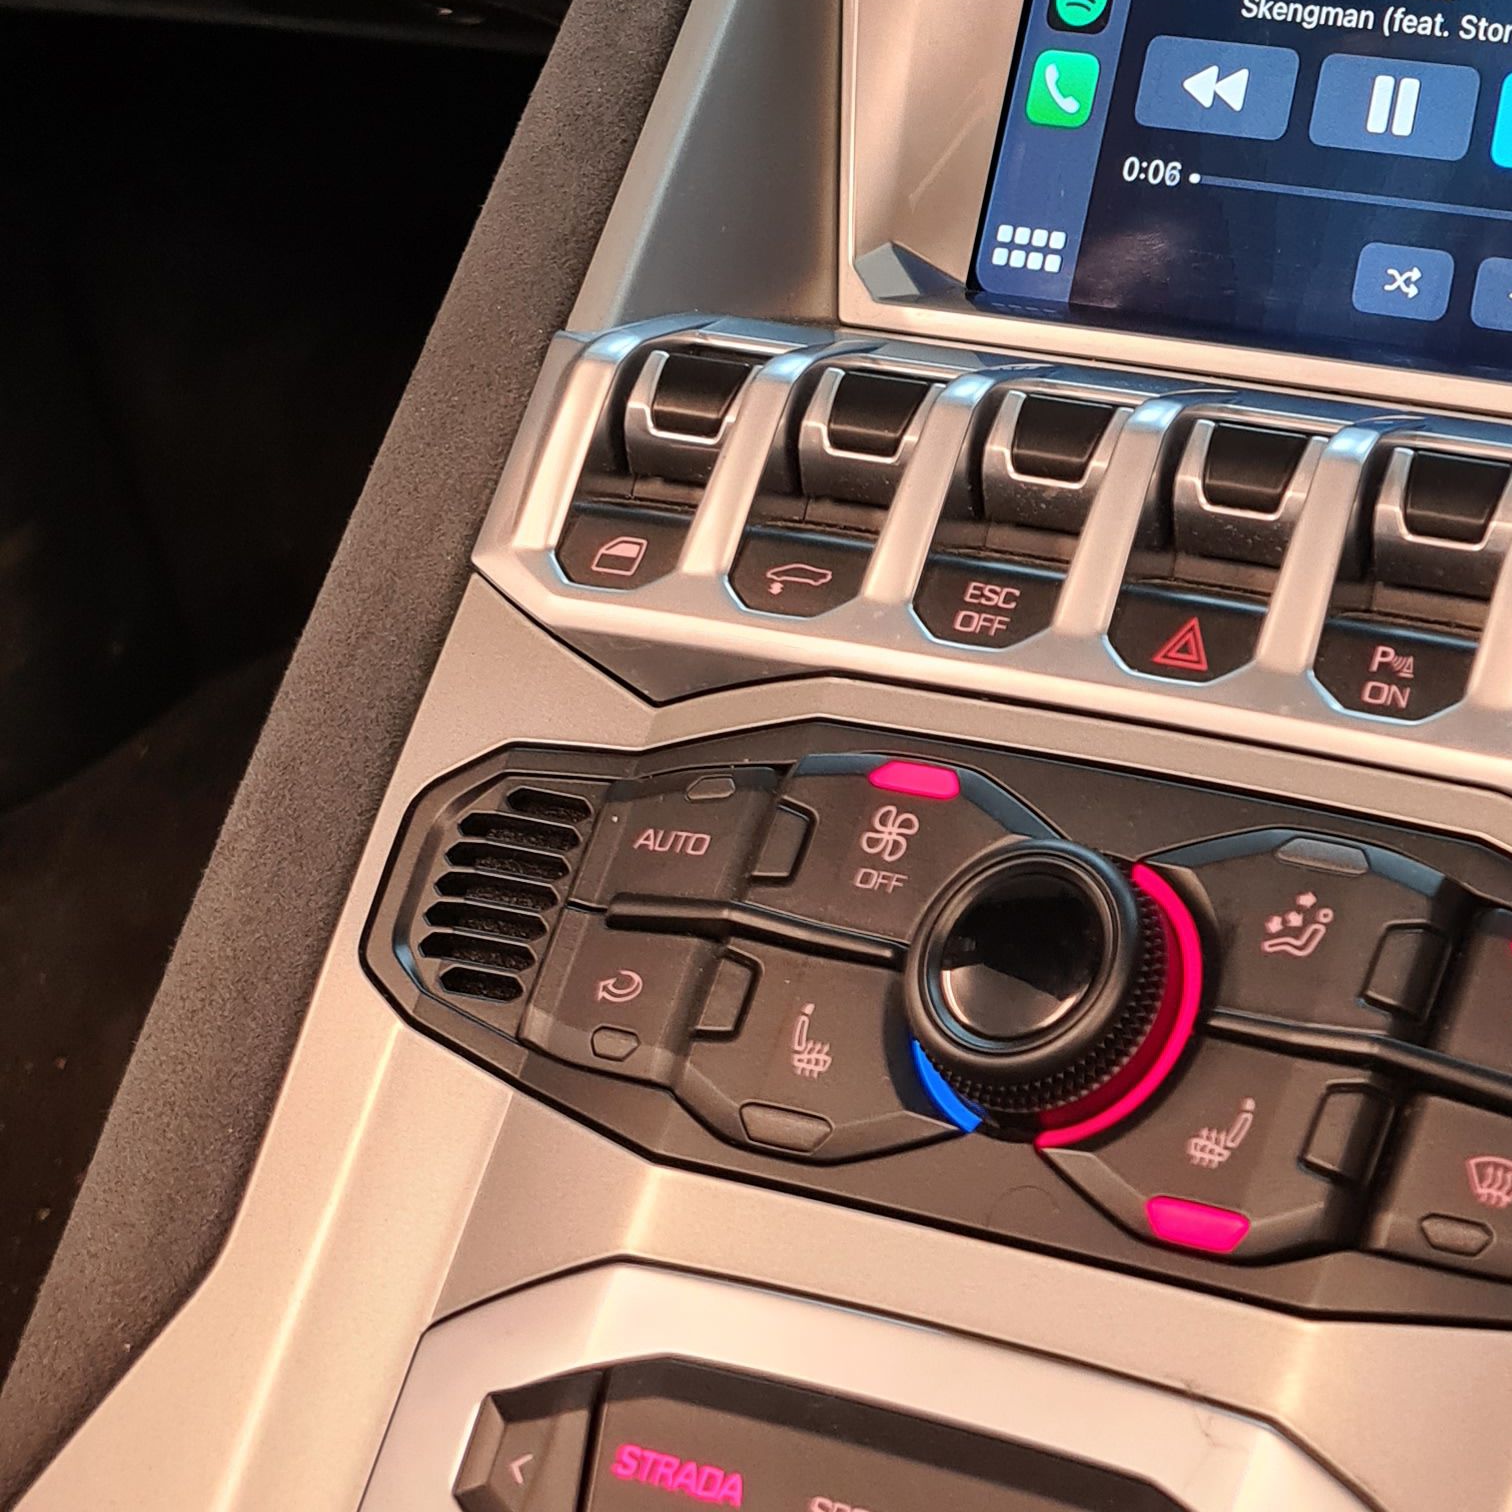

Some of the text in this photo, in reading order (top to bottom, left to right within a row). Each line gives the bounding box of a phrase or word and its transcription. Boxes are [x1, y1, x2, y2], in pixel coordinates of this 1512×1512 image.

[1382, 6, 1450, 37] (feat.
[1121, 158, 1183, 188] 0:06
[964, 582, 1021, 609] ESC
[953, 610, 1010, 637] OFF
[1363, 681, 1411, 709] ON
[633, 828, 711, 856] AUTO
[853, 868, 907, 894] OFF
[611, 1444, 745, 1508] STRADA
